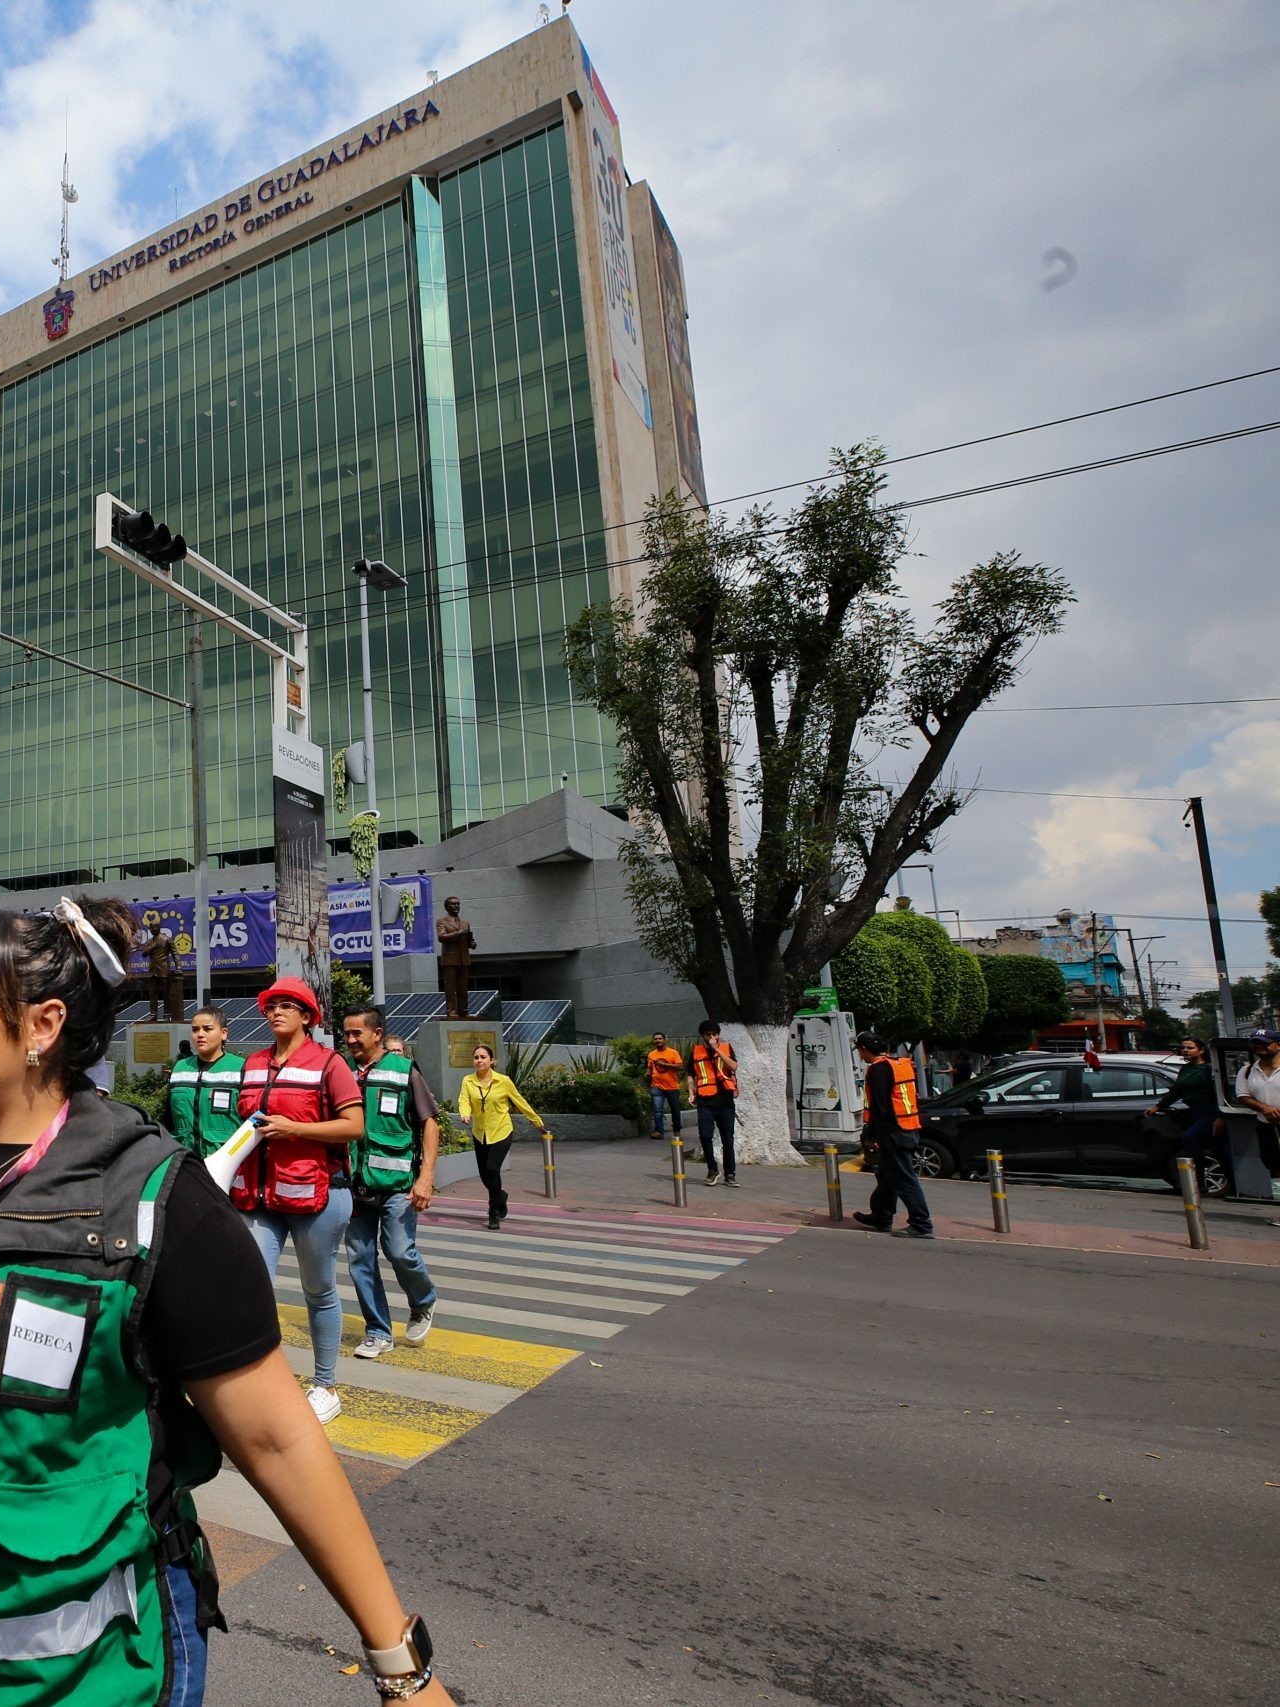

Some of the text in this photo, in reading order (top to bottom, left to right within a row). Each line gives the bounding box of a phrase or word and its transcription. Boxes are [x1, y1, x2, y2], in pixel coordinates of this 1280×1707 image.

[88, 99, 440, 292] UNIVERSIDAD DE GUADALAJARA
[168, 192, 314, 273] RECTORÍA GENERAL
[278, 744, 320, 772] REVELACIONES
[193, 903, 245, 922] 024
[355, 899, 370, 908] IMA
[333, 933, 401, 950] OCTURE
[12, 1325, 74, 1352] REBECA
